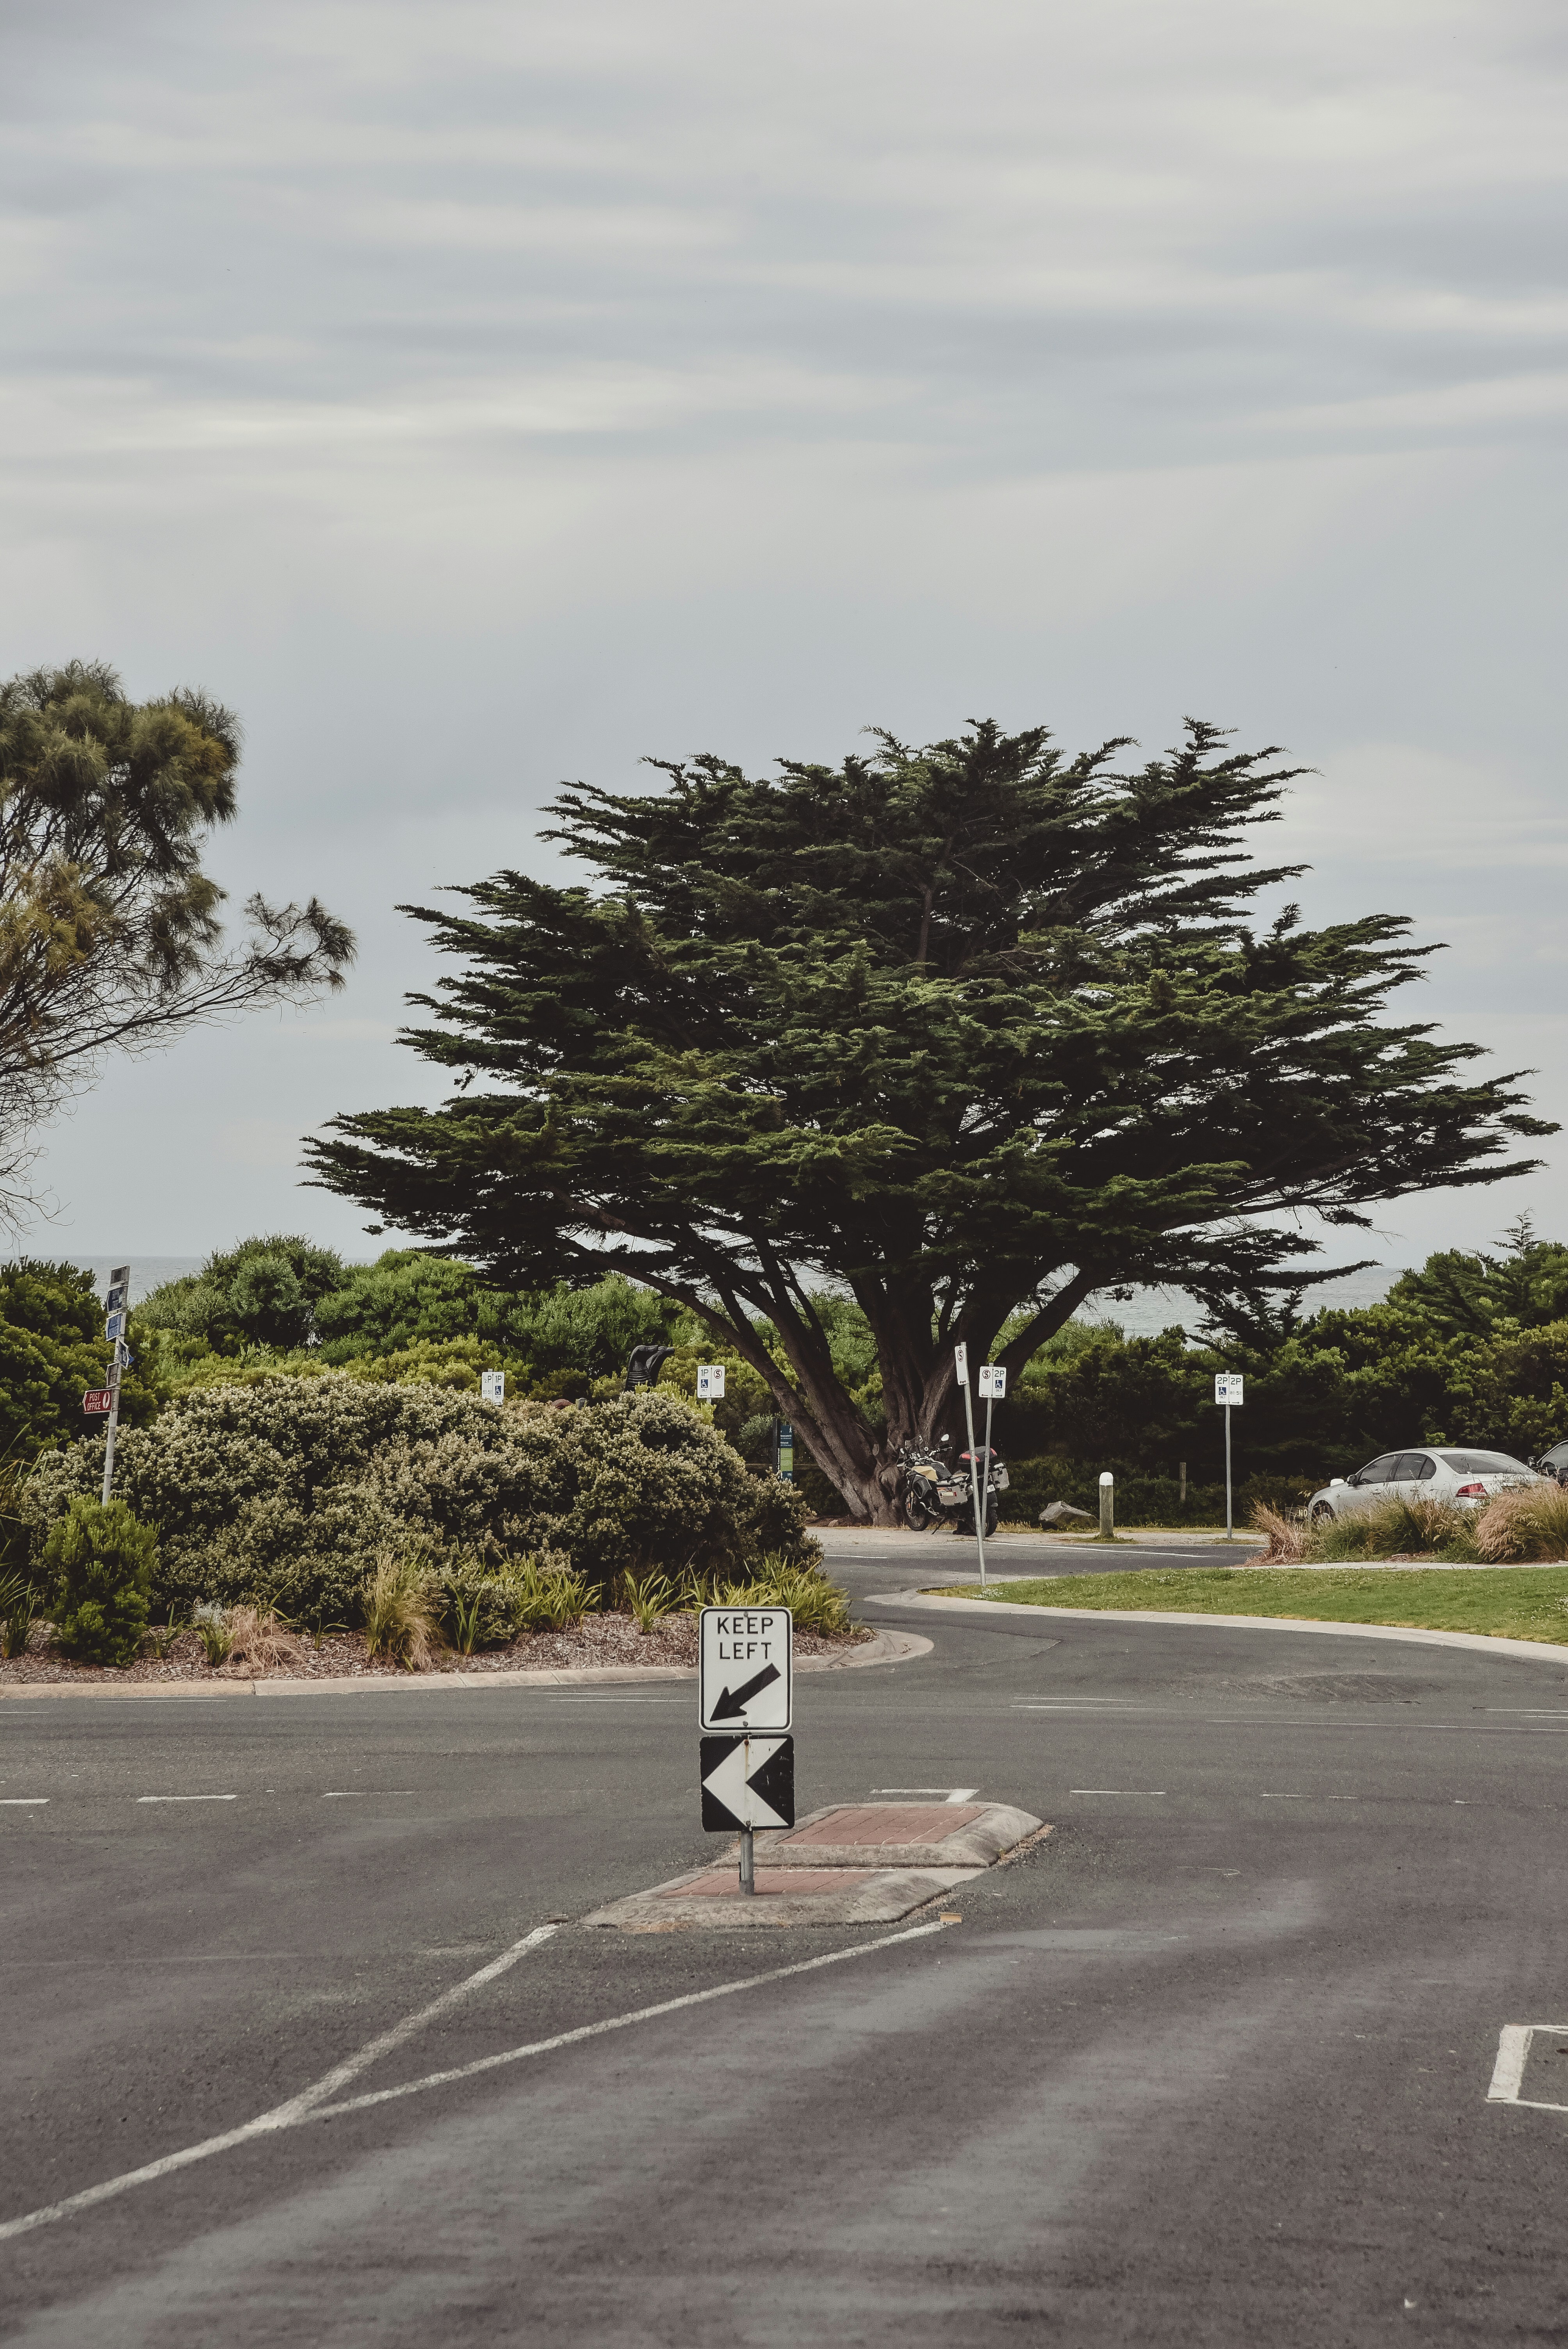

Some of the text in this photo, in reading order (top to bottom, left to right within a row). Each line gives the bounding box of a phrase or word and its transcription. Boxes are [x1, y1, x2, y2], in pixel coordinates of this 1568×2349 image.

[1217, 1376, 1228, 1385] 2P
[89, 1392, 100, 1402] POST
[87, 1401, 101, 1411] OFFICE
[717, 1616, 773, 1634] KEEP
[720, 1642, 772, 1659] LEFT
